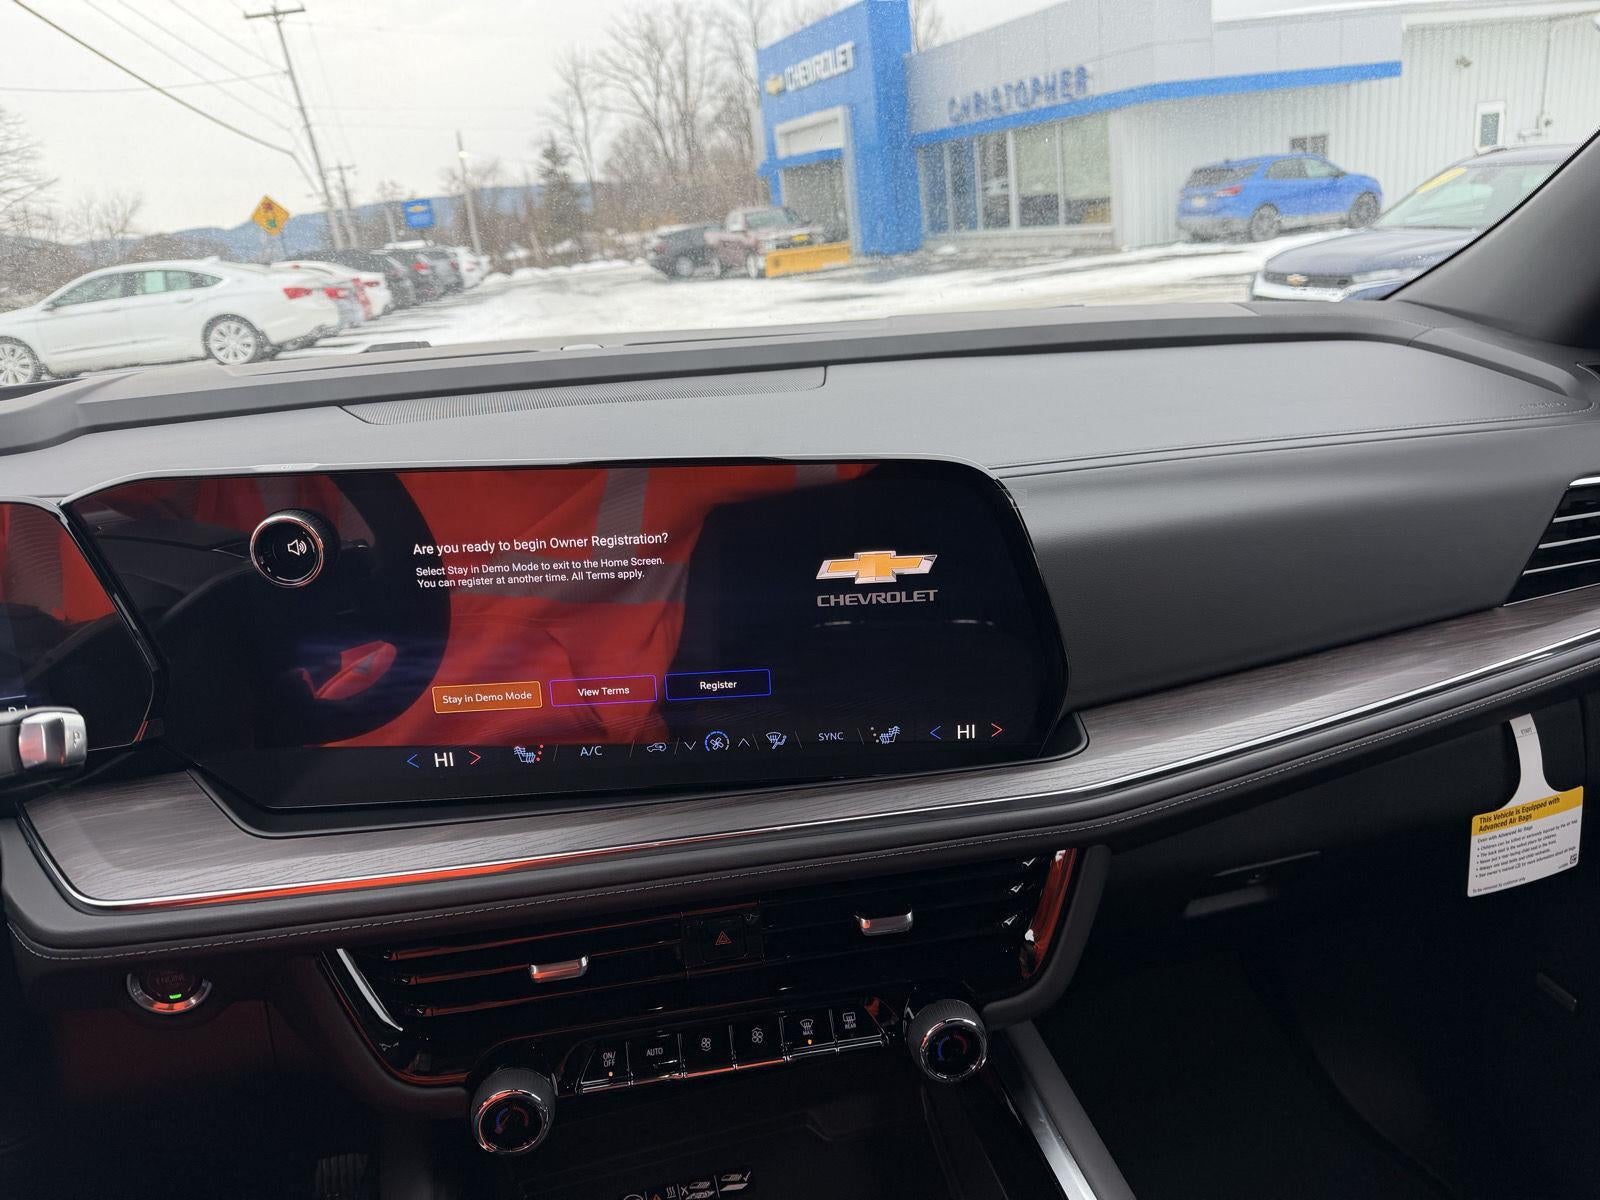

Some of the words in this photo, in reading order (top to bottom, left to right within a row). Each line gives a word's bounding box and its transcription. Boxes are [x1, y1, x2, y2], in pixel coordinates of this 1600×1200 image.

[784, 41, 855, 92] CHEVROLET
[947, 65, 1089, 122] CHRISTOPHER
[413, 544, 434, 555] Are
[437, 544, 459, 556] you
[462, 540, 495, 554] ready
[499, 541, 510, 551] to
[514, 538, 546, 552] begin
[550, 537, 588, 549] Owner
[591, 532, 669, 548] Registration?
[416, 566, 446, 576] Select
[447, 566, 468, 576] Stay
[470, 565, 480, 574] in
[482, 564, 510, 573] Demo
[512, 562, 539, 572] Mode
[541, 562, 550, 571] to
[552, 561, 570, 570] exit
[571, 561, 582, 569] to
[584, 559, 598, 568] the
[600, 558, 629, 568] Home
[630, 557, 665, 566] Screen.
[417, 579, 436, 588] You
[438, 580, 456, 588] can
[458, 576, 494, 588] register
[496, 576, 506, 584] at
[507, 574, 543, 584] another
[545, 574, 569, 582] time.
[571, 572, 584, 581] All
[586, 571, 616, 580] Terms
[618, 568, 645, 580] apply.
[816, 589, 939, 608] CHEVROLET
[577, 688, 600, 697] View
[601, 686, 630, 696] Terms
[700, 681, 738, 692] Register
[442, 695, 463, 705] Stay
[464, 694, 474, 703] in
[475, 694, 504, 702] Demo
[505, 691, 532, 700] Mode
[818, 732, 844, 742] SYNC
[956, 724, 976, 740] HI
[434, 751, 454, 768] HI
[580, 746, 602, 757] A/C
[1480, 816, 1492, 824] This
[1492, 810, 1514, 820] Vehicle
[1522, 802, 1547, 814] Equipped
[1548, 797, 1560, 806] with
[1478, 821, 1508, 832] Advanced
[1508, 817, 1516, 825] Air
[1518, 814, 1532, 823] Bags
[844, 1022, 857, 1030] REAR
[602, 1050, 616, 1060] ON/
[646, 1047, 664, 1057] AUTO
[604, 1059, 616, 1068] OFF
